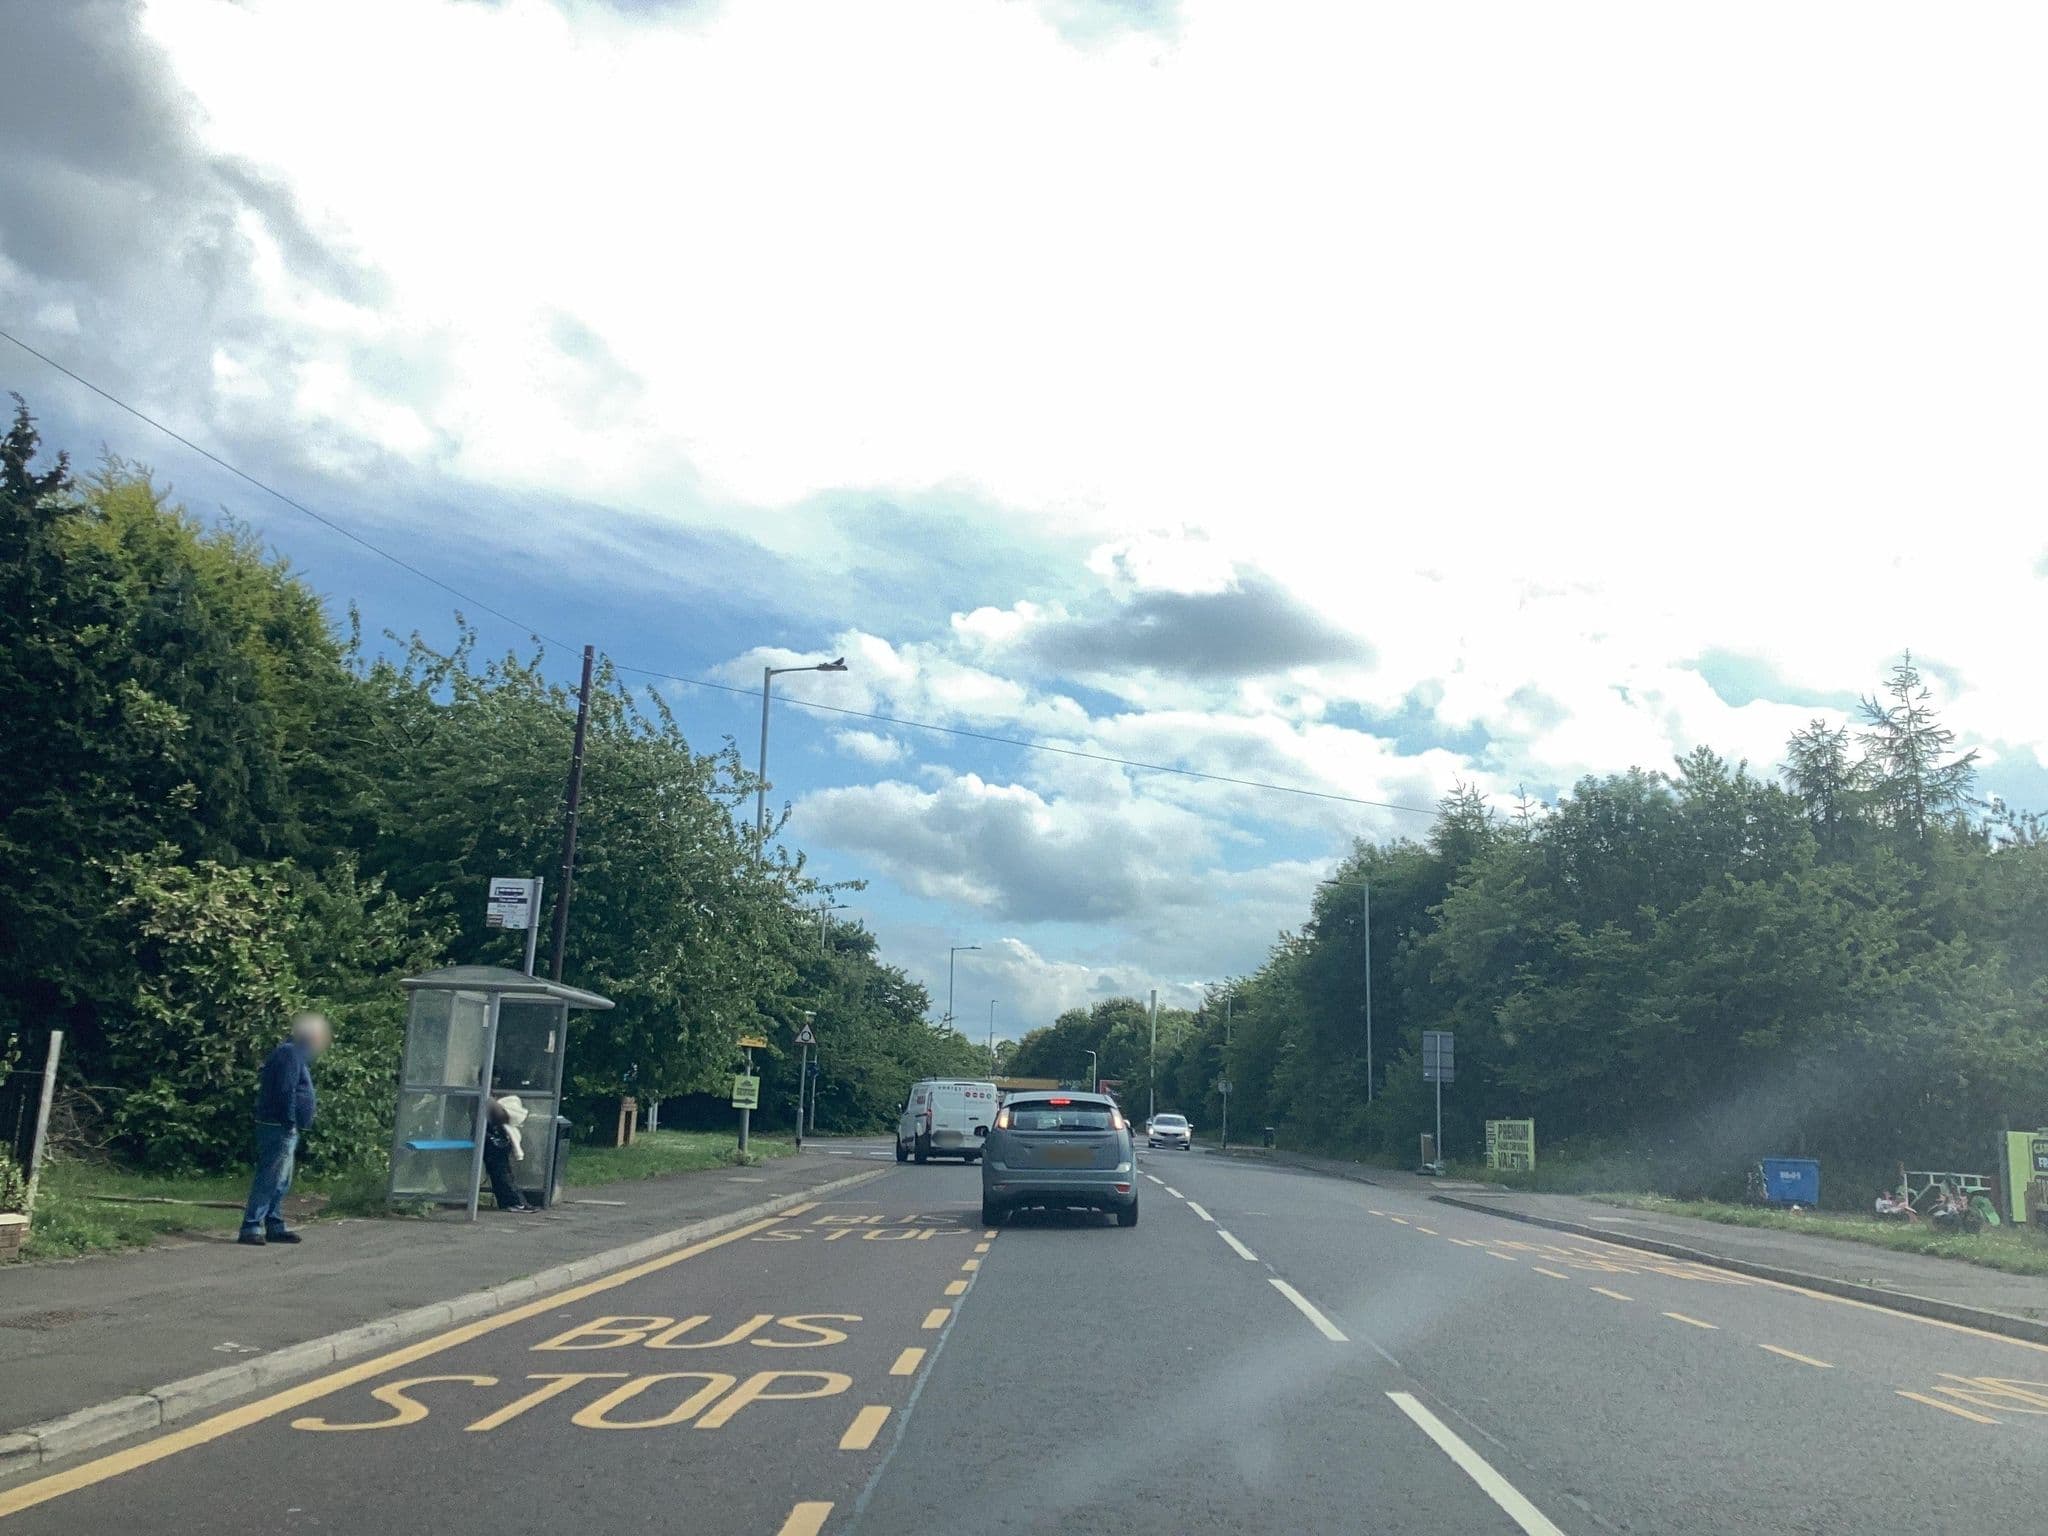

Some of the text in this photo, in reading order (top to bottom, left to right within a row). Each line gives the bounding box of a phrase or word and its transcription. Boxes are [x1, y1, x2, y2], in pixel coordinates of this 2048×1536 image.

[812, 1214, 964, 1225] BUS
[750, 1228, 972, 1241] STOP
[529, 1313, 863, 1351] BUS
[291, 1370, 854, 1432] STOP
